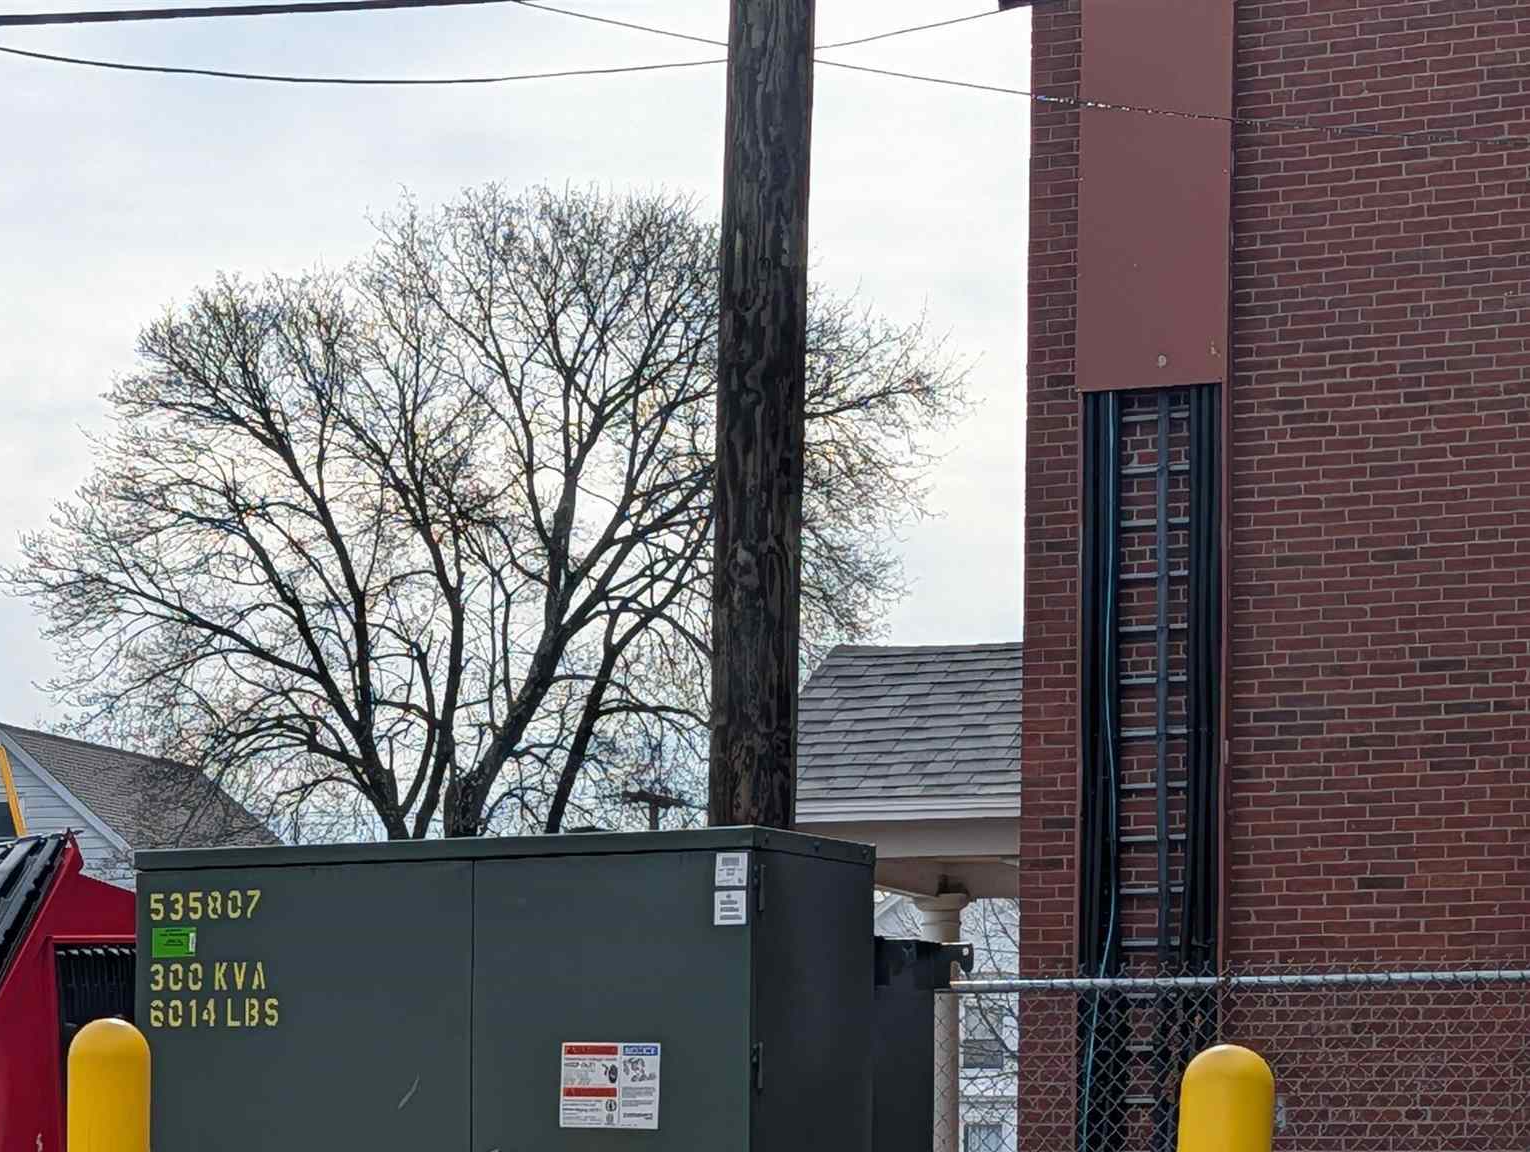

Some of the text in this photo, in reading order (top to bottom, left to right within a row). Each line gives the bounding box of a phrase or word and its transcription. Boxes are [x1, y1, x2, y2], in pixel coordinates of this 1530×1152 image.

[150, 889, 262, 921] 535807
[150, 961, 266, 992] 300 KVA
[150, 998, 279, 1028] 6014 LBS
